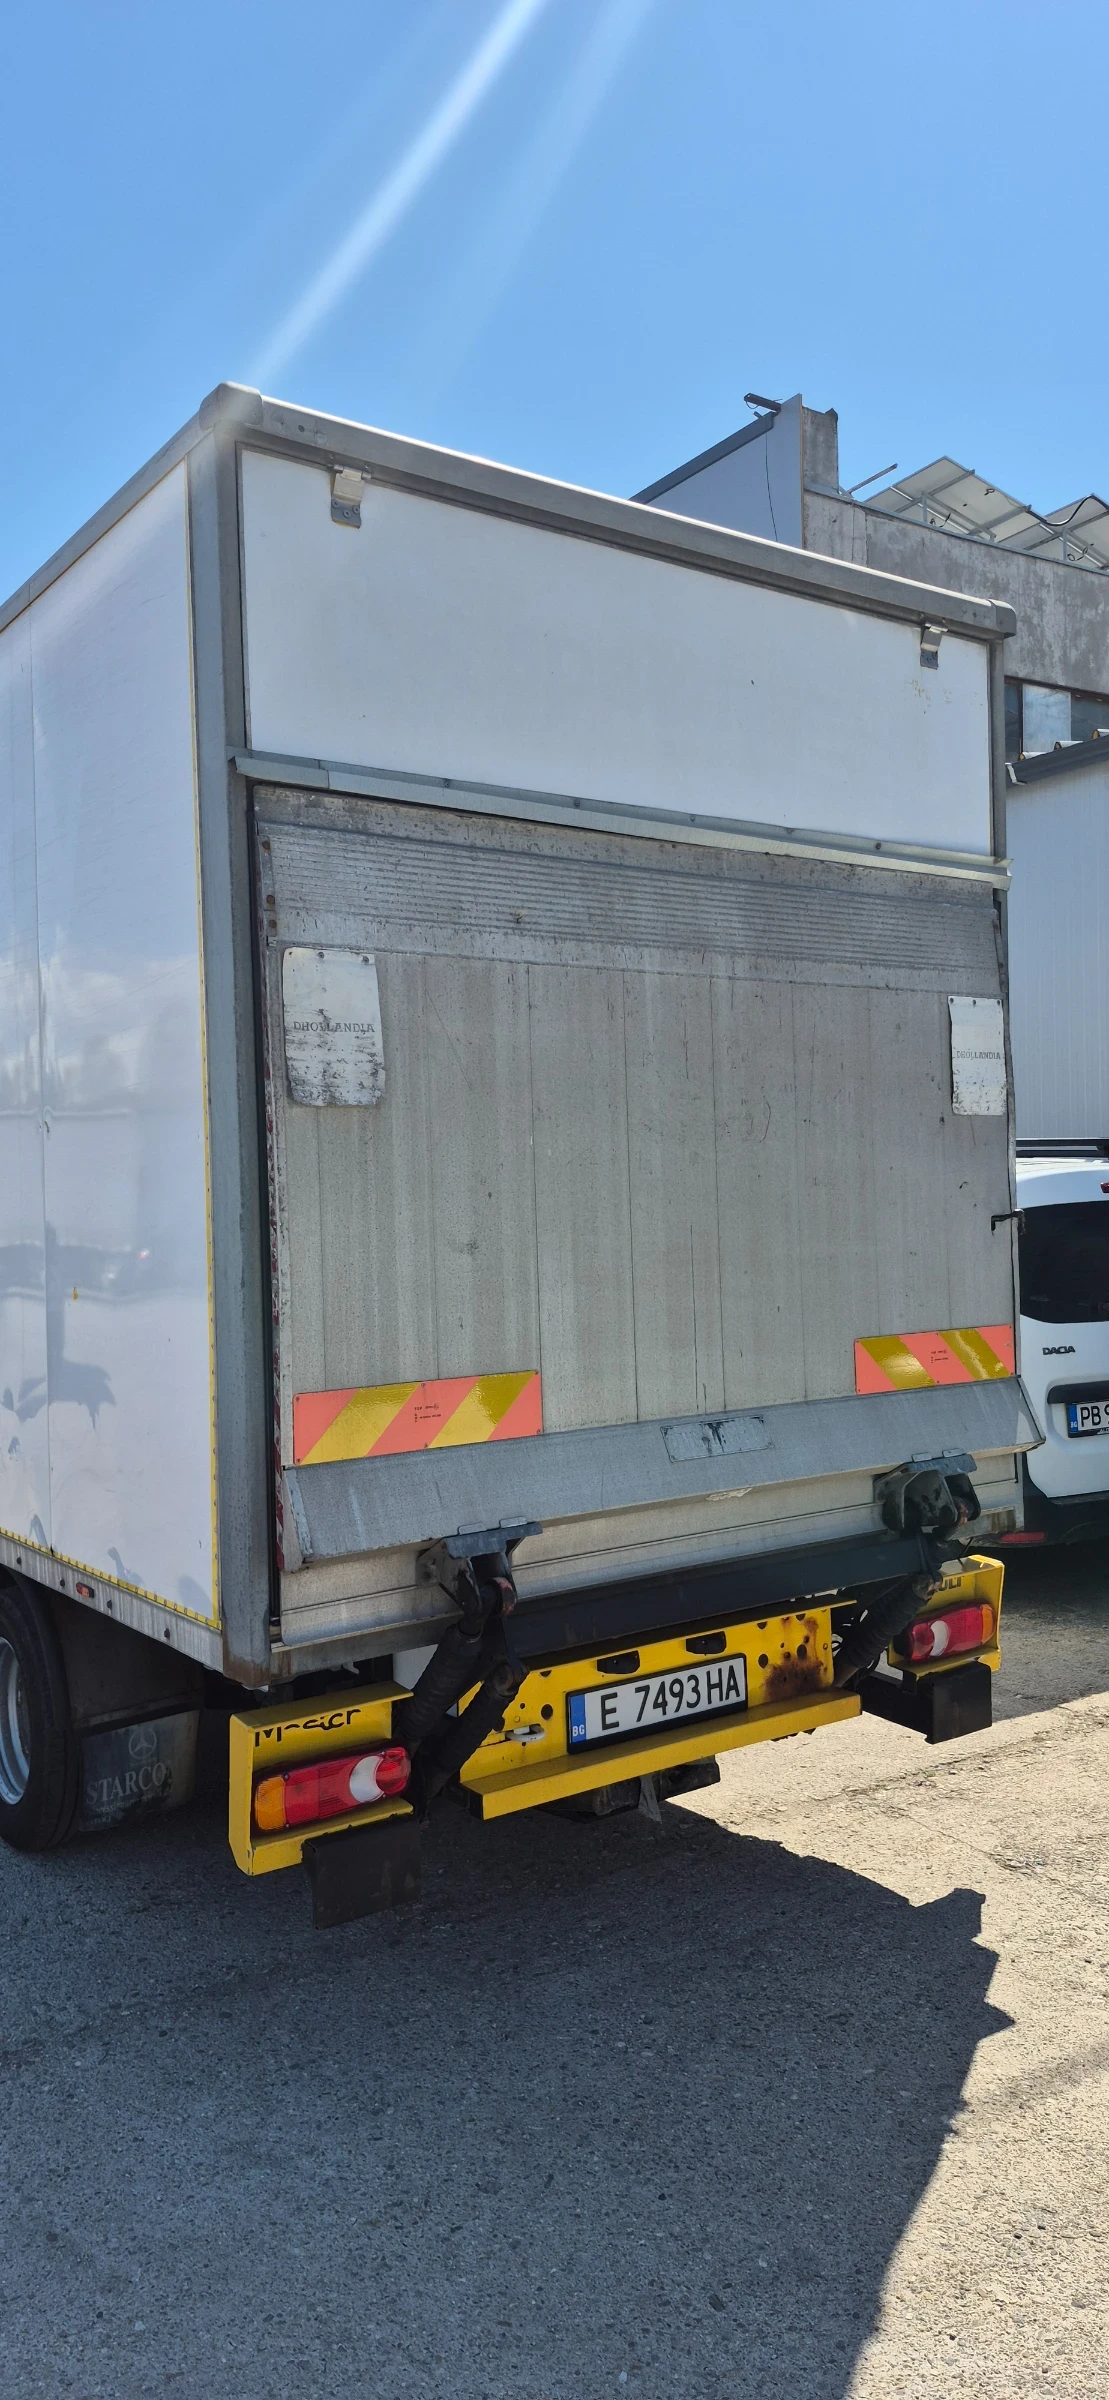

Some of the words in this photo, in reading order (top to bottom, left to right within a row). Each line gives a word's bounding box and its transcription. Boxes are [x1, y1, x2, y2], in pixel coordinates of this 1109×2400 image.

[293, 1021, 375, 1033] DHOLLANDIA
[956, 1050, 1001, 1060] DHOLLANDIA
[1042, 1345, 1076, 1355] DACIA
[1070, 1421, 1078, 1429] BG
[1080, 1405, 1101, 1427] PB
[572, 1724, 586, 1737] BG
[600, 1692, 620, 1731] E
[634, 1674, 701, 1723] 7493
[706, 1664, 741, 1705] HA
[254, 1708, 361, 1748] Mster
